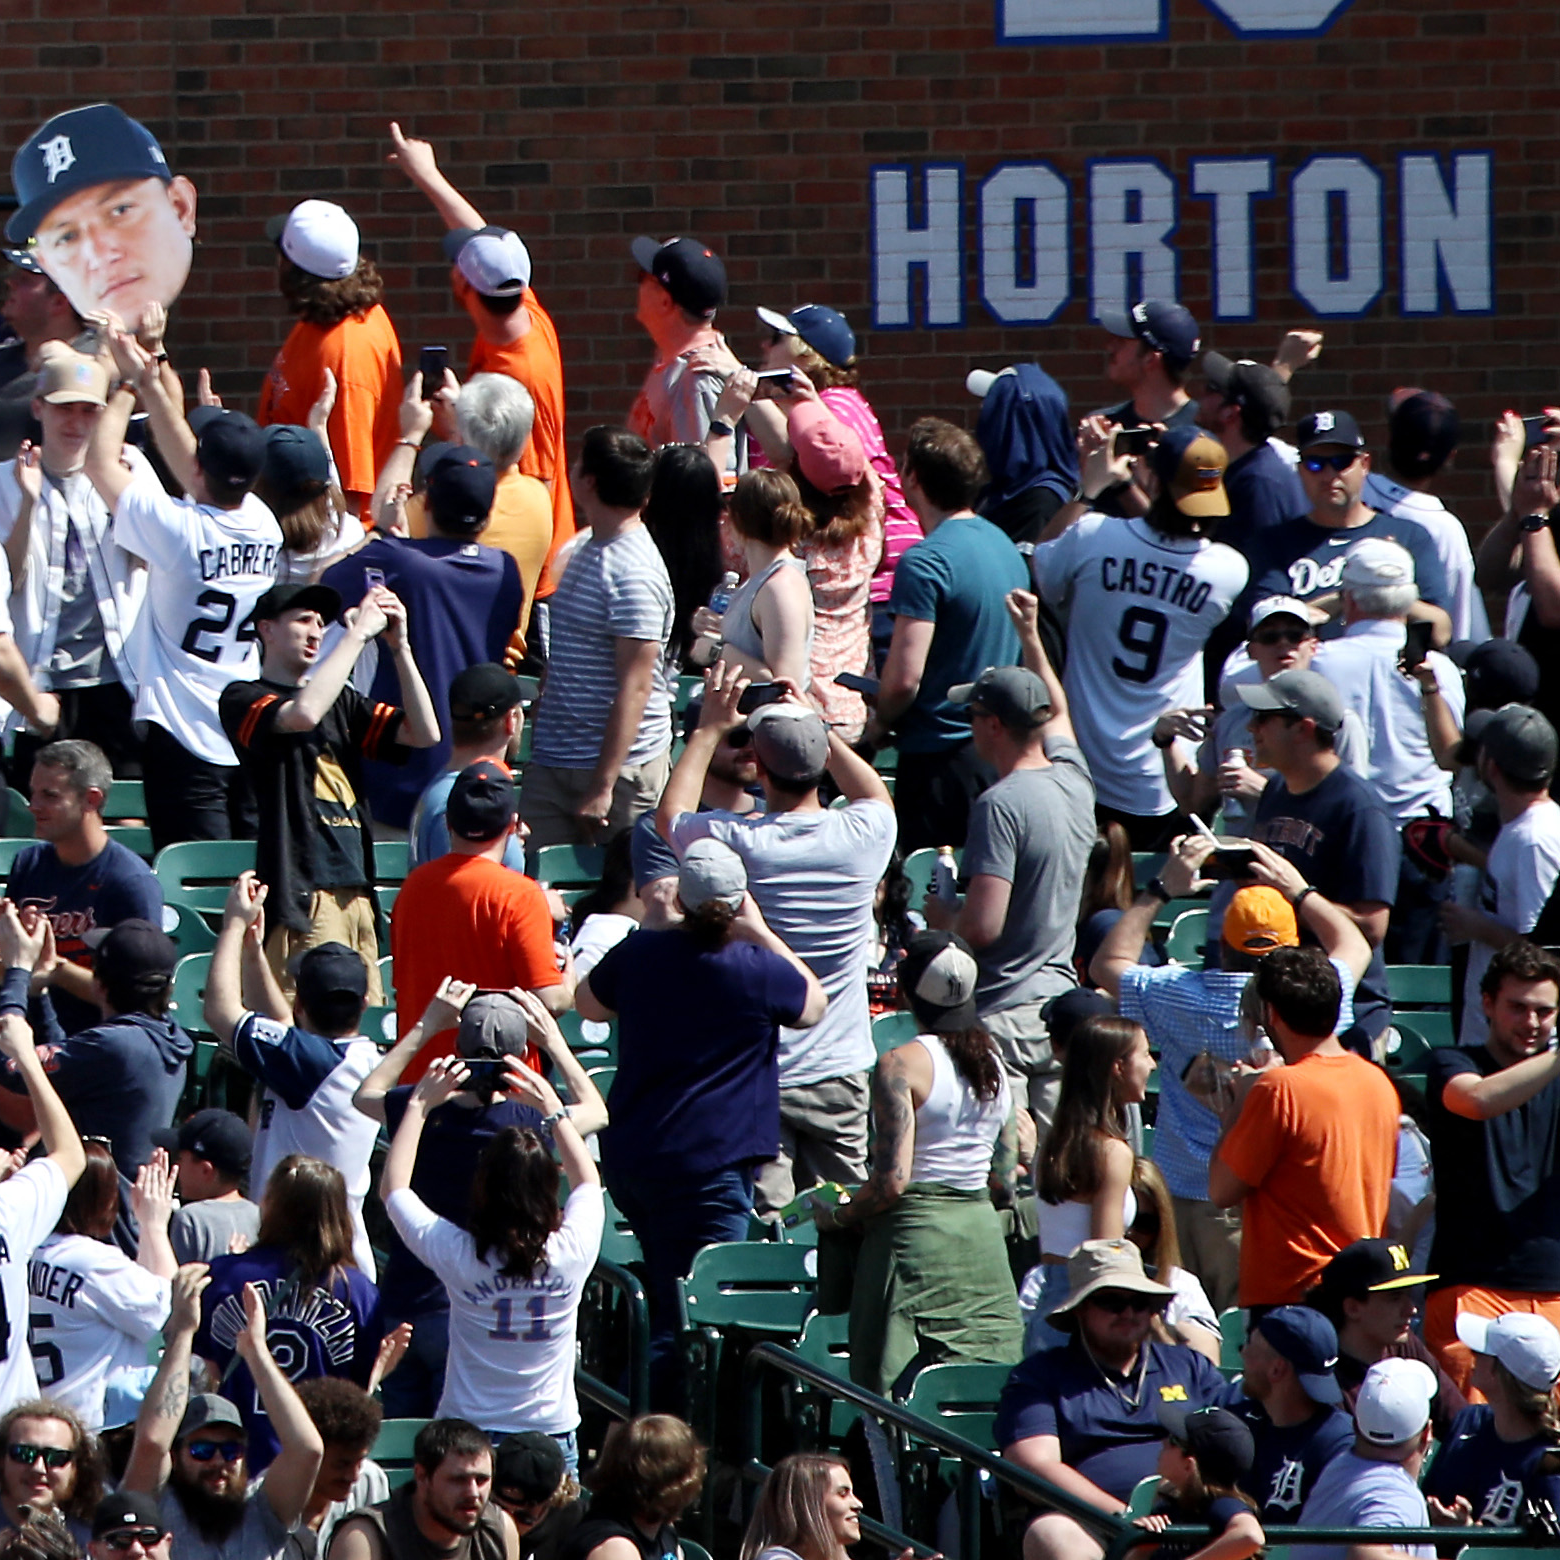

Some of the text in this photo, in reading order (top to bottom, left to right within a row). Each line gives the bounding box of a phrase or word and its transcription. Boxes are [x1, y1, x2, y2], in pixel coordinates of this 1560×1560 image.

[871, 149, 1494, 329] HORTON
[200, 542, 281, 582] CABRER
[1102, 556, 1213, 614] CASTRO
[1112, 604, 1169, 684] 9
[488, 1297, 552, 1342] 11
